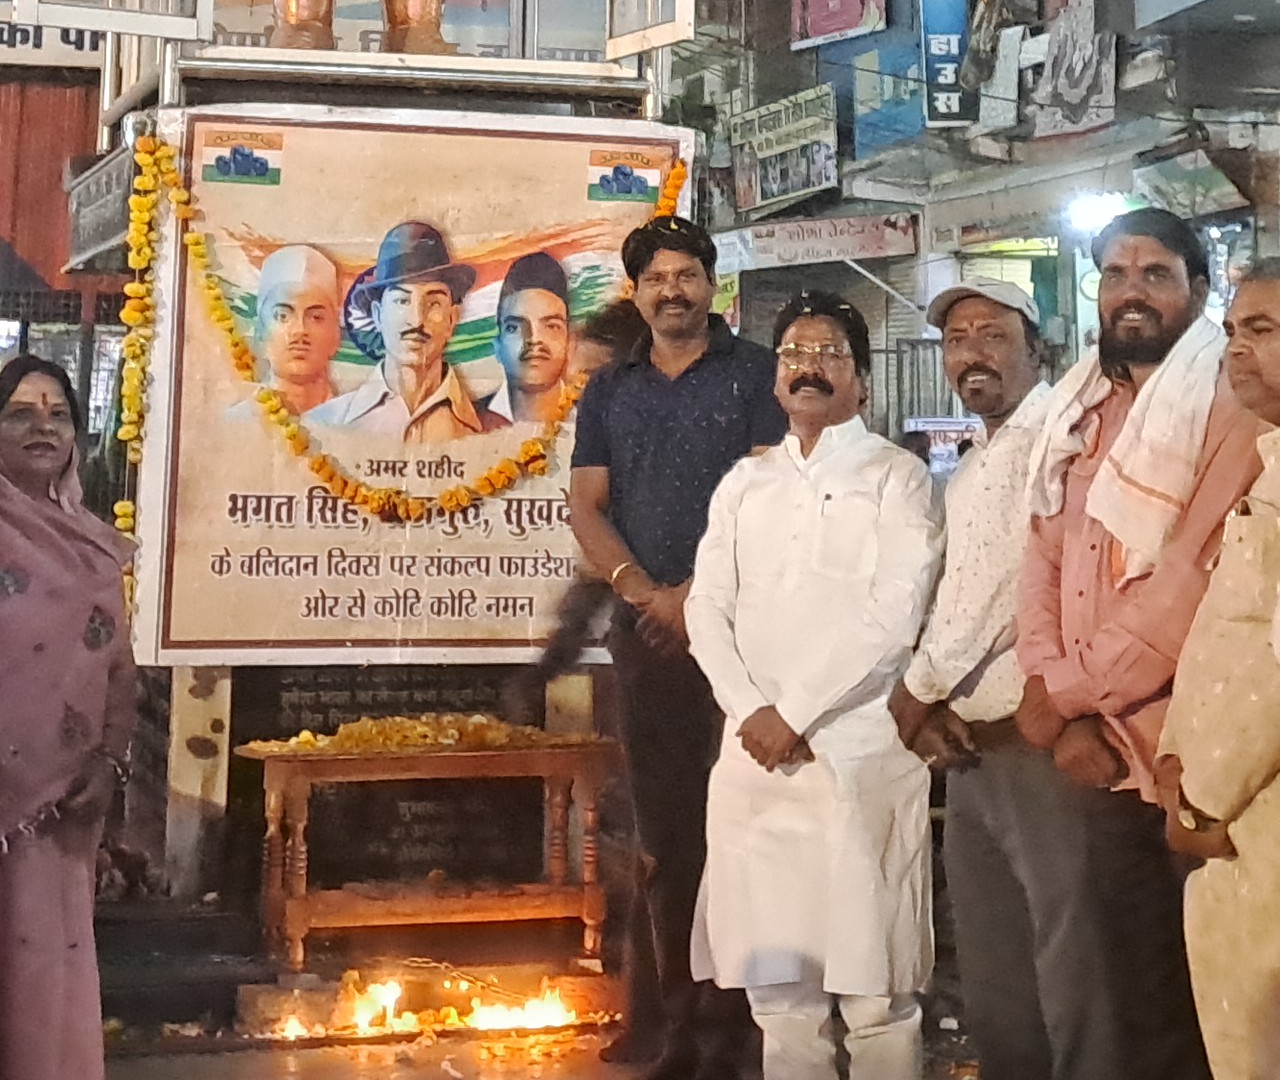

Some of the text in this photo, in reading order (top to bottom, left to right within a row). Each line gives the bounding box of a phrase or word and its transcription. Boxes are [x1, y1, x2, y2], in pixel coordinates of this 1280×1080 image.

[364, 455, 466, 479] अमर शहीद
[228, 492, 296, 524] भगत
[501, 488, 571, 537] सुखदे
[211, 547, 577, 579] के बलिदान दिवस पर संकल्प फाउंडेश
[301, 588, 534, 618] ओर से कोटि कोटि नमन
